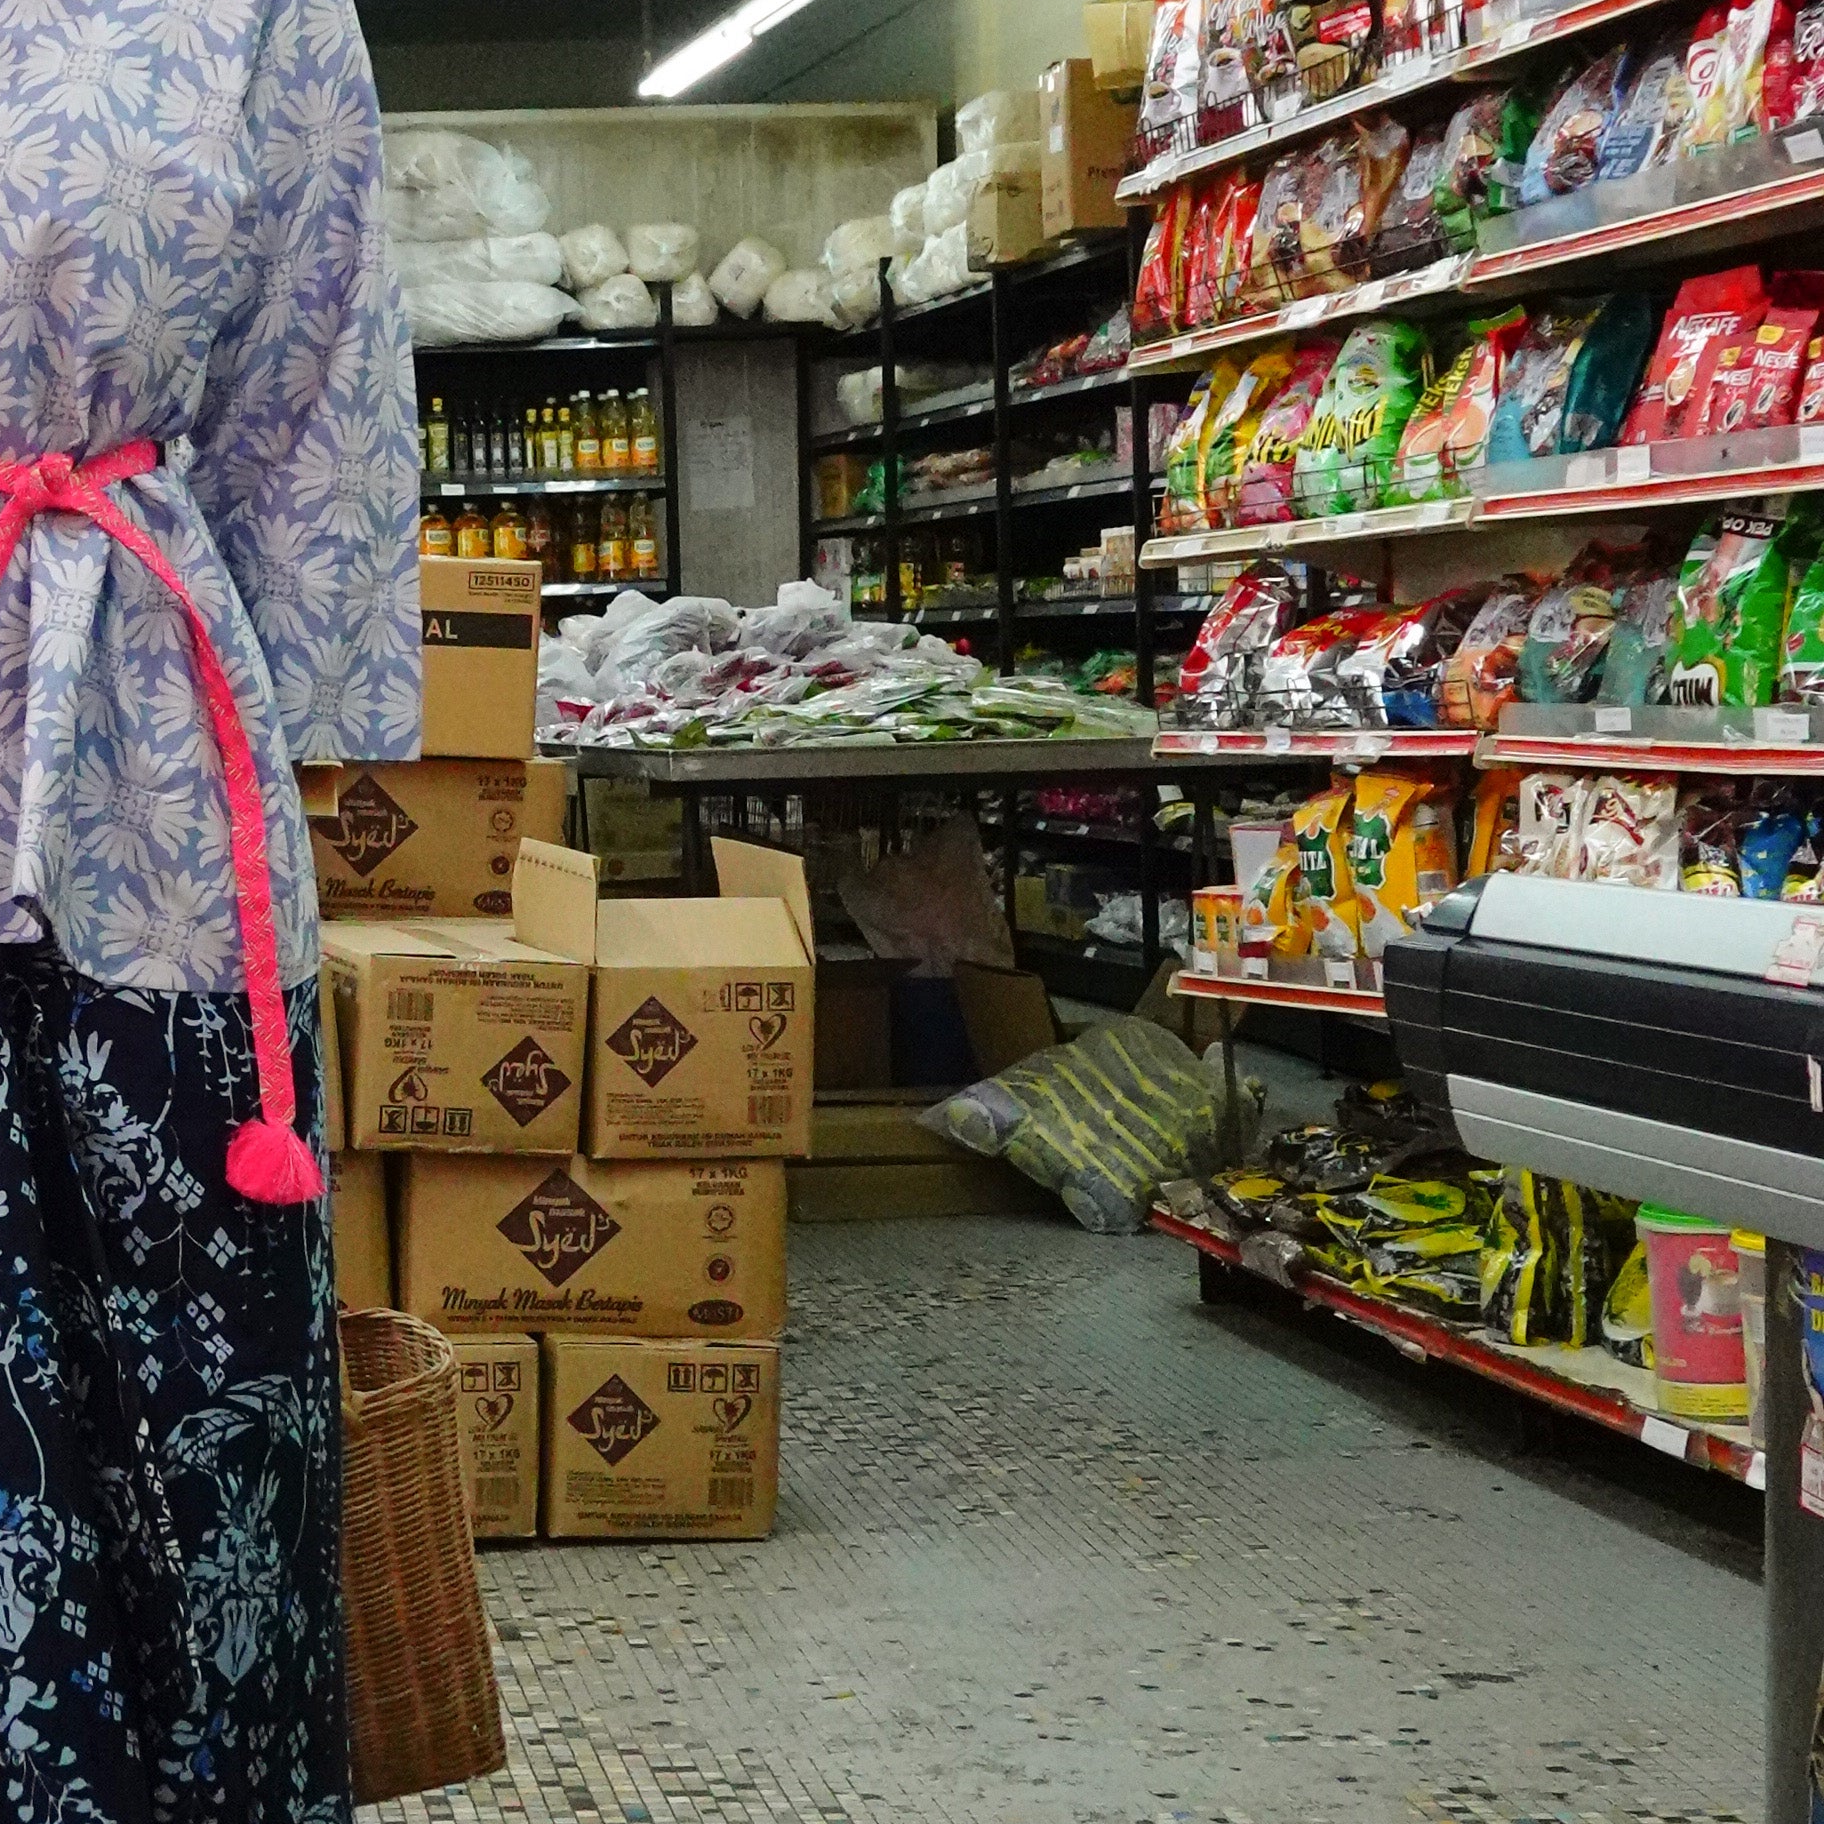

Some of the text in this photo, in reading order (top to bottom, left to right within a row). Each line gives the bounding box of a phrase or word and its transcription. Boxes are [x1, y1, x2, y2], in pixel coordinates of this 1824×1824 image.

[426, 619, 458, 639] AL
[442, 1286, 508, 1313] Minyak
[513, 1287, 572, 1311] Masak
